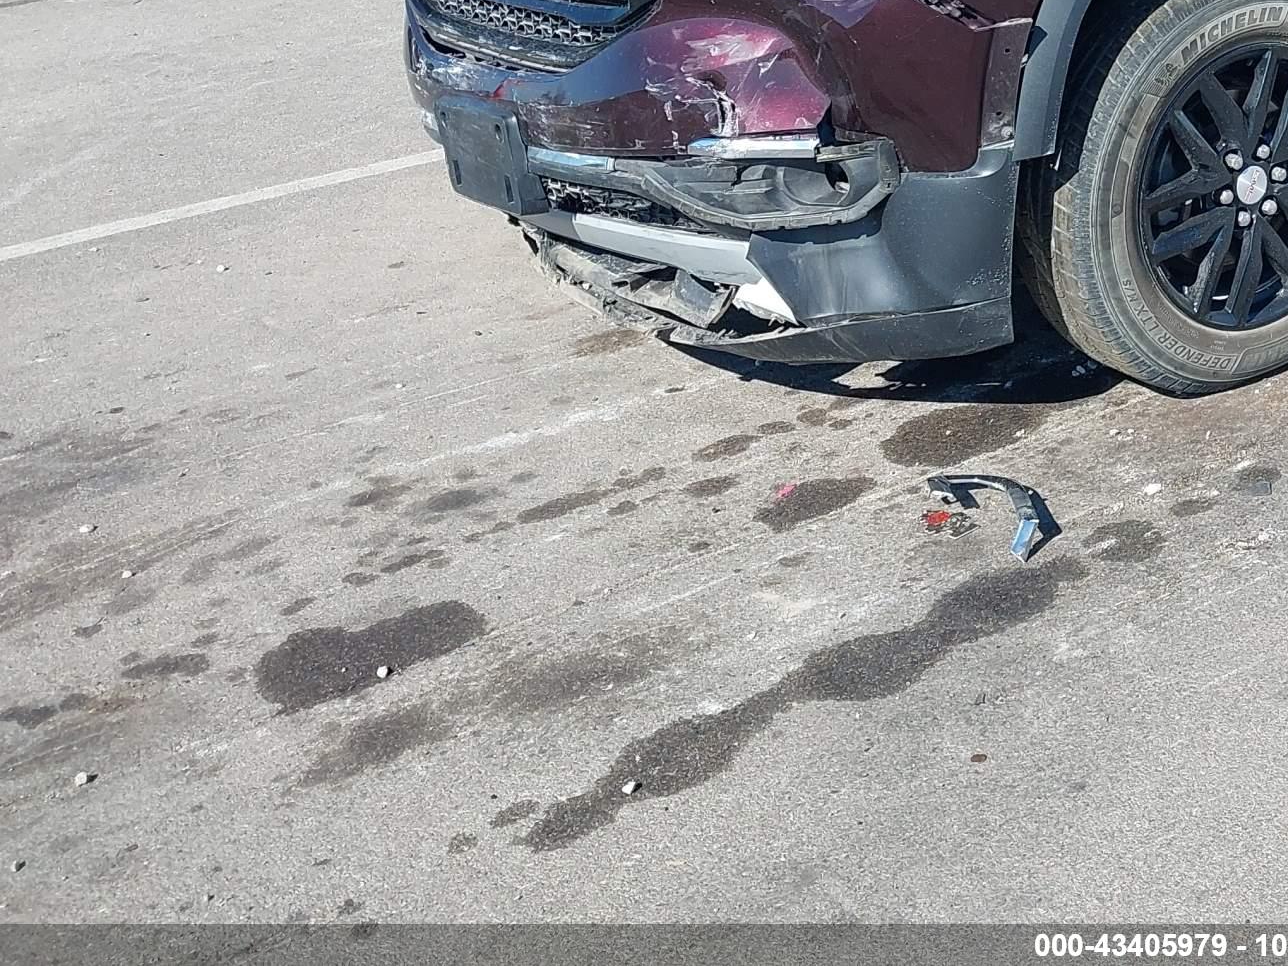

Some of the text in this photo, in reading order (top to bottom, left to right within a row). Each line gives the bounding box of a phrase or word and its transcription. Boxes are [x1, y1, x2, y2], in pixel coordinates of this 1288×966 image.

[1179, 6, 1284, 65] MICHELIN
[1121, 279, 1138, 303] M/S
[1134, 304, 1160, 331] LTX
[1157, 332, 1232, 370] DEFENDER
